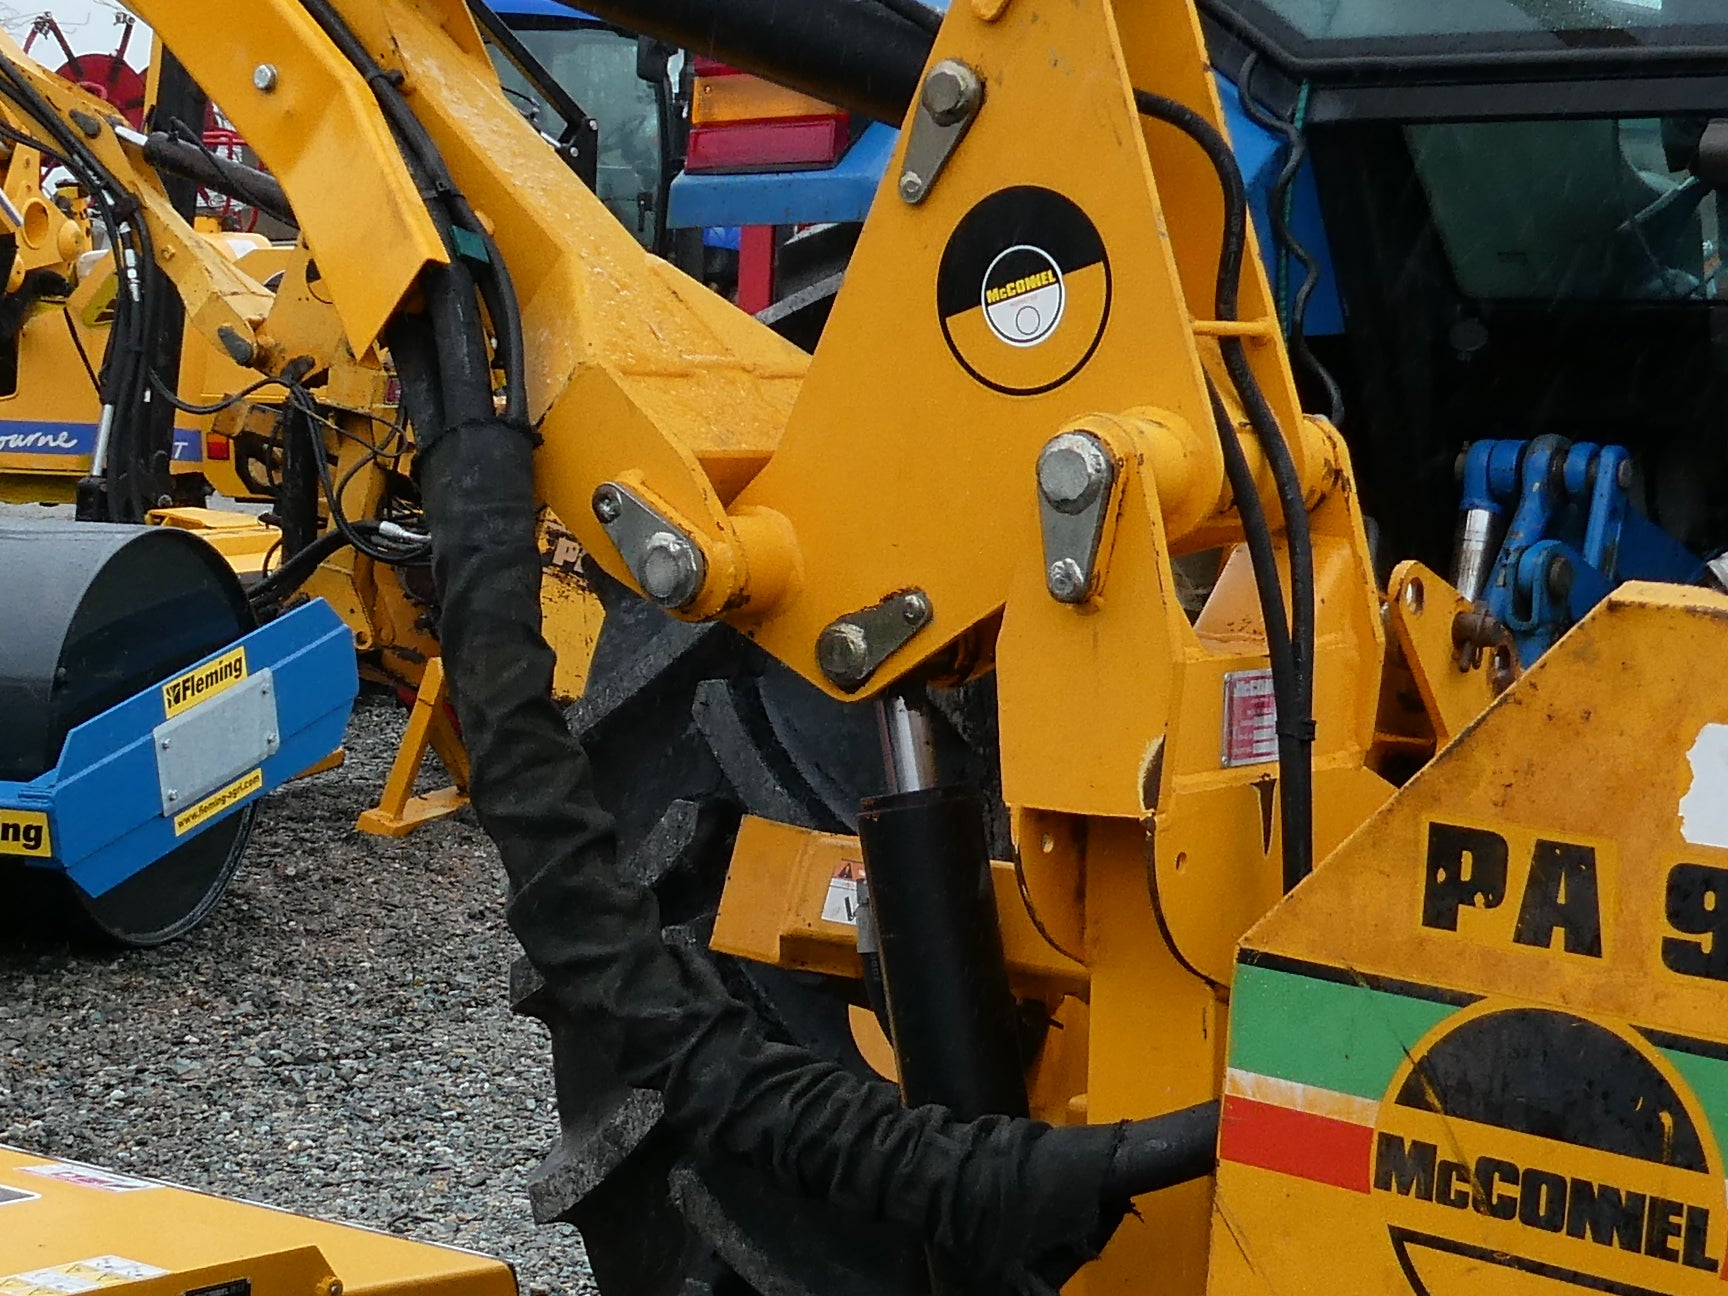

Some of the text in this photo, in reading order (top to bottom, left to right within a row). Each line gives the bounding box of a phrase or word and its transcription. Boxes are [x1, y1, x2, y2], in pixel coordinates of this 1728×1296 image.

[985, 268, 1057, 304] McCONNEL
[181, 654, 244, 704] Fleming
[1421, 821, 1603, 959] PA
[1373, 1130, 1720, 1275] McCONNEL
